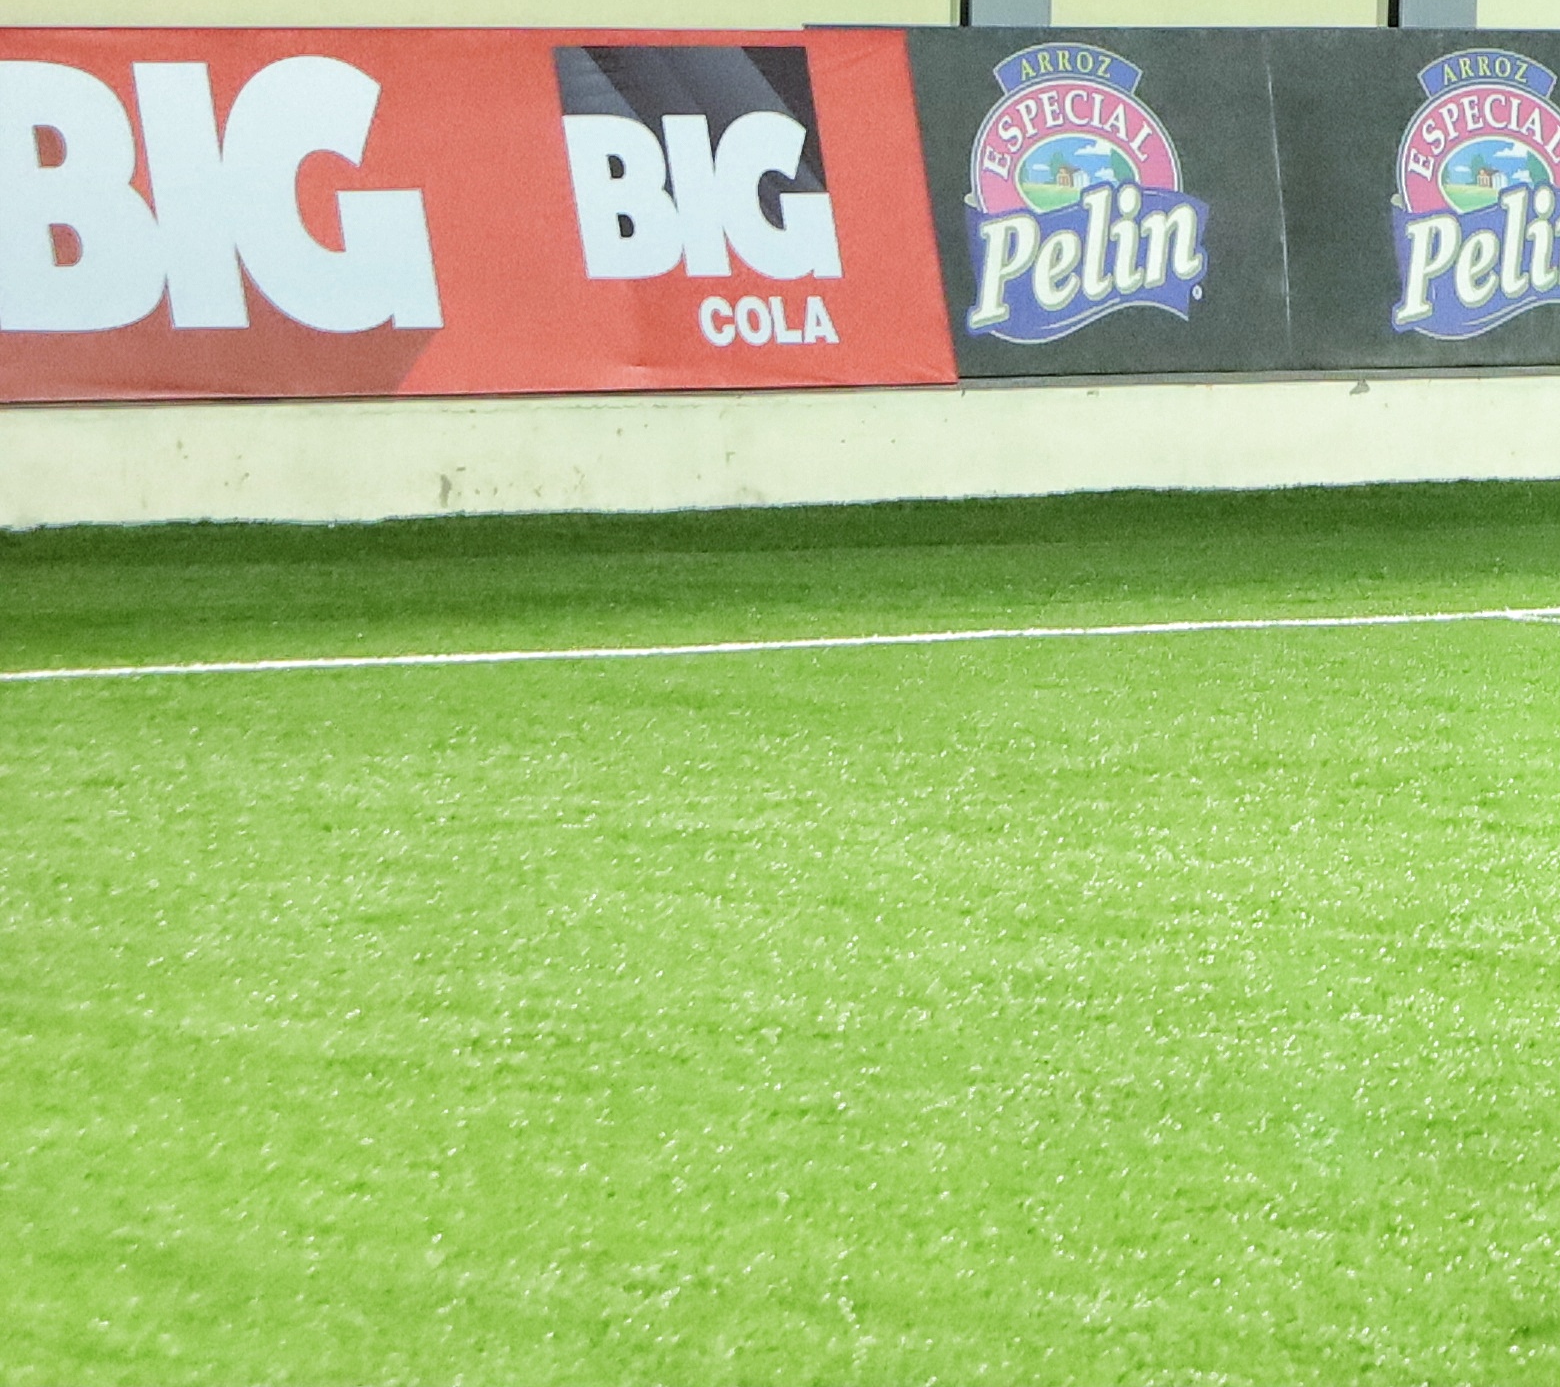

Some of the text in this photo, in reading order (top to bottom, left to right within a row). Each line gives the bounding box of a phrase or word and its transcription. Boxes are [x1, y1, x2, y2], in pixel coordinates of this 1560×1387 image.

[1019, 49, 1113, 81] ARROZ
[1442, 54, 1530, 86] ARROZ
[981, 88, 1153, 181] ESPECIAL
[0, 56, 444, 330] BIG
[562, 112, 844, 280] BIG
[972, 185, 1201, 324] Pelin
[699, 294, 839, 347] COLA
